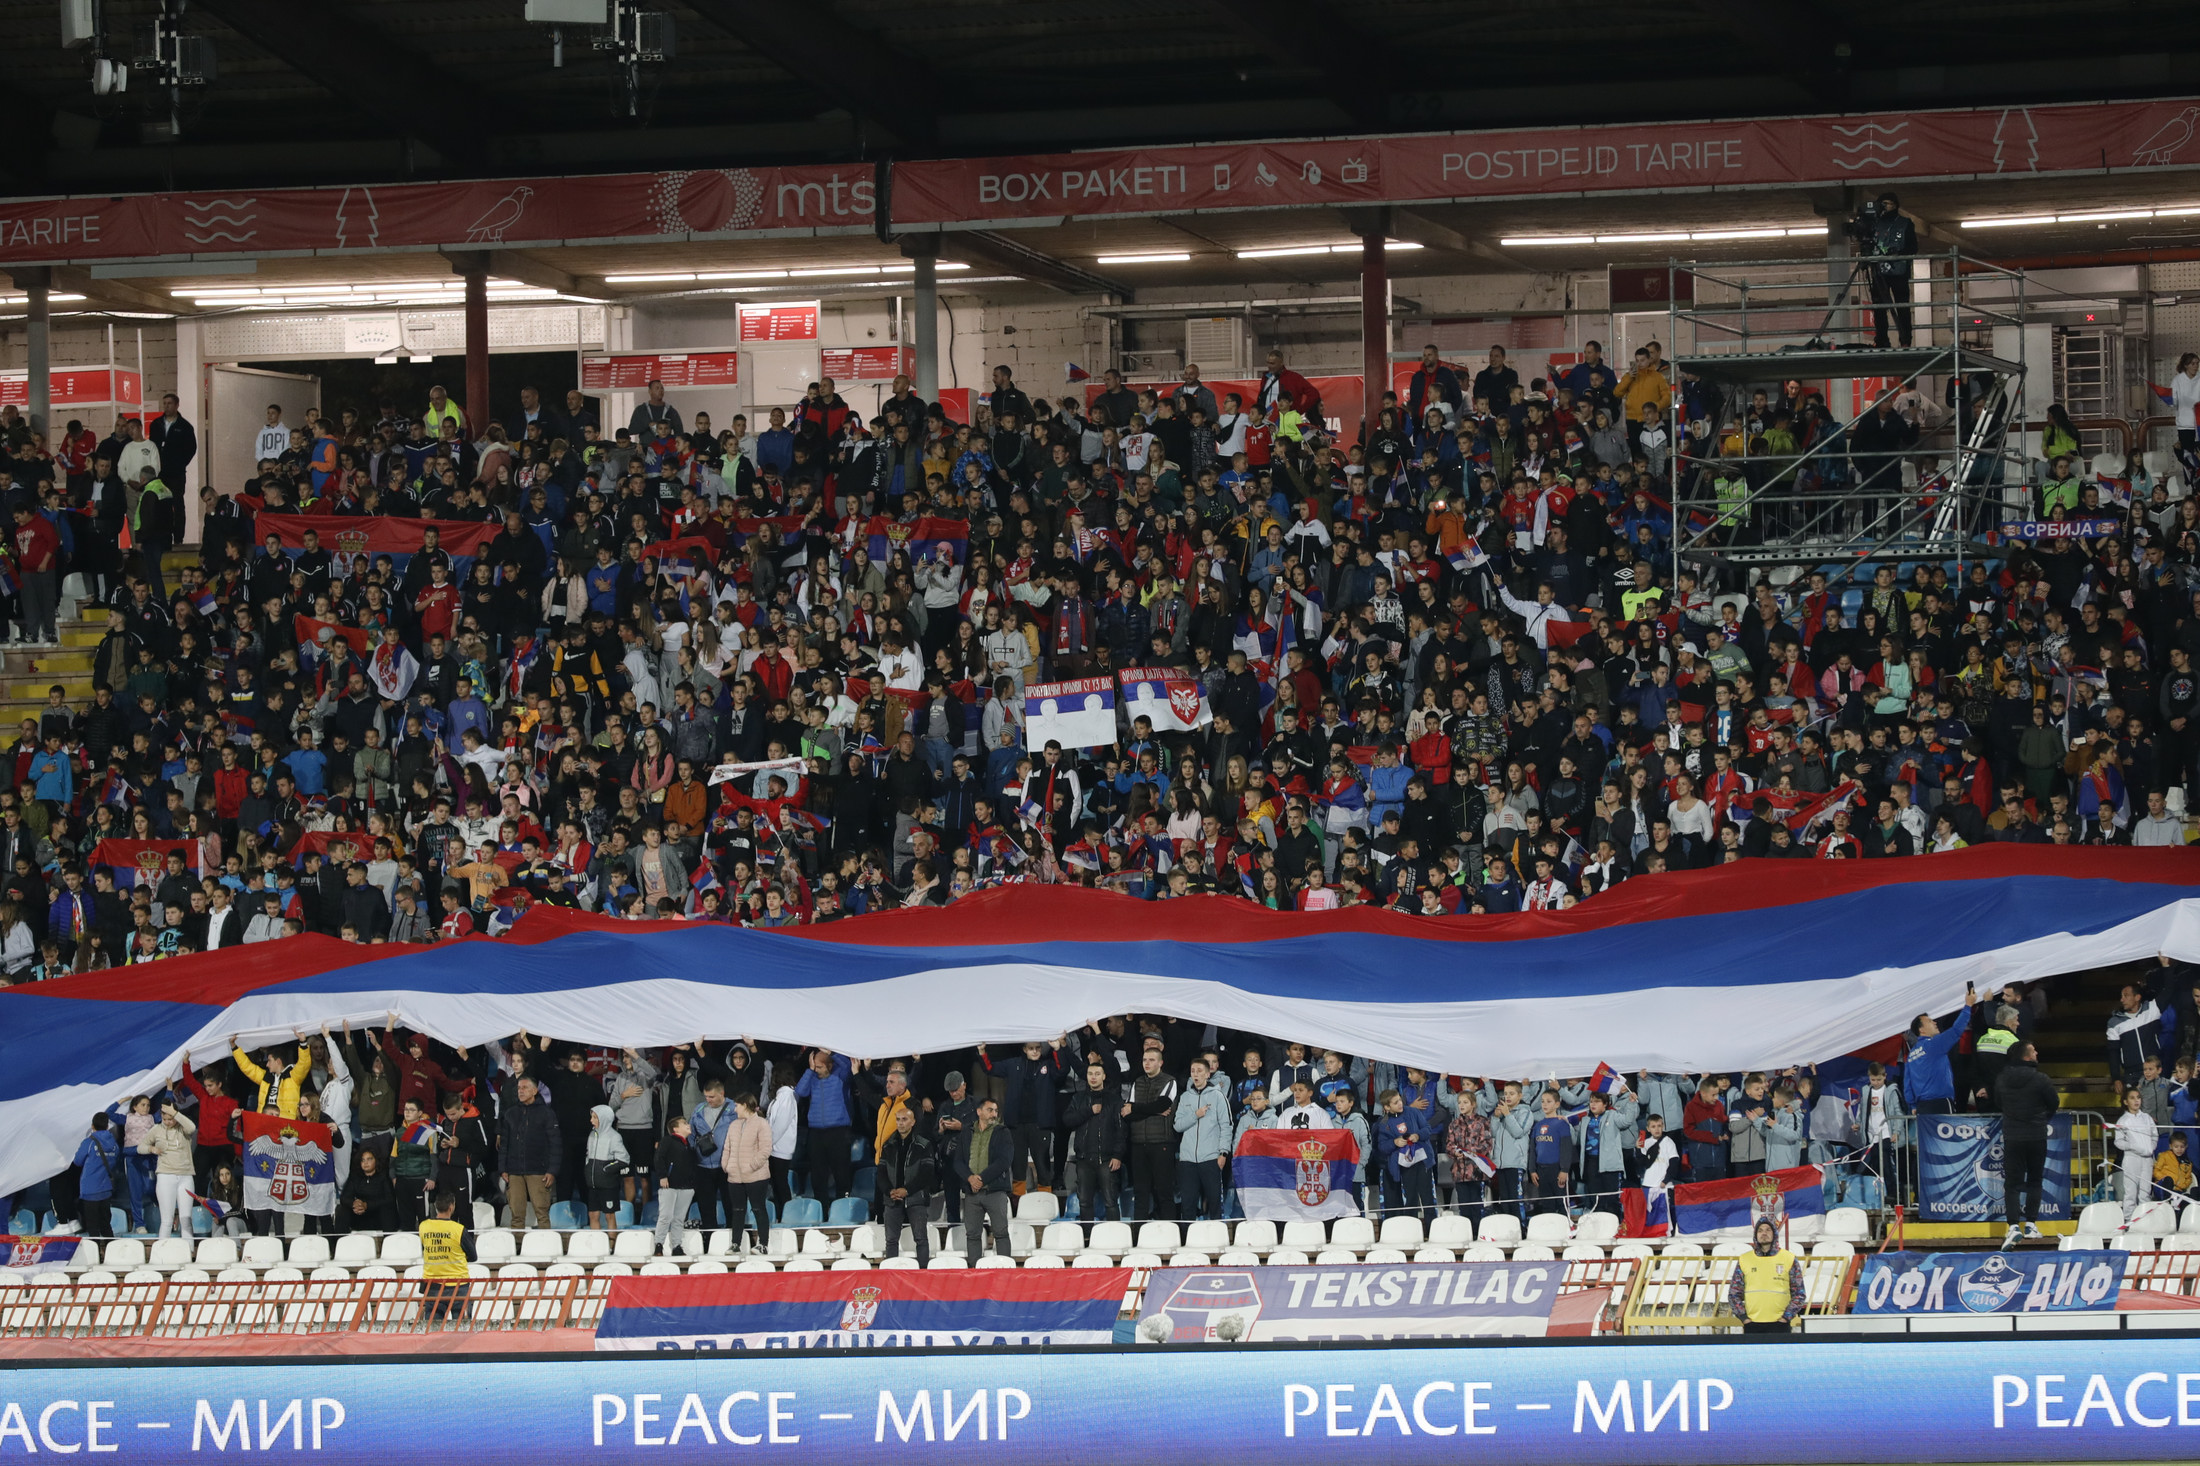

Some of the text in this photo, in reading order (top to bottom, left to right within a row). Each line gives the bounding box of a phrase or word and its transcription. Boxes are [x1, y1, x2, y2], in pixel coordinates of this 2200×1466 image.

[1442, 139, 1743, 181] POSTPEJD TARIFE
[777, 167, 876, 216] mts
[980, 165, 1186, 203] BOX PAKETI
[0, 215, 100, 247] TARIFE
[2023, 522, 2093, 538] СРБИЈА
[1083, 679, 1091, 692] СУ
[1091, 678, 1100, 691] УЗ
[1101, 677, 1112, 690] ВАС
[1755, 738, 1765, 750] 10
[1936, 1122, 1991, 1141] ОФК
[1930, 1201, 1989, 1215] КОСОВСКА
[1287, 1267, 1549, 1309] TEKSTILAC
[1867, 1260, 2114, 1312] ОФК ДИФ
[1979, 1275, 2001, 1283] ОФК
[1192, 1295, 1252, 1307] TEKSTILAC
[1173, 1327, 1217, 1340] DERVE
[592, 1390, 800, 1446] PEACE
[874, 1387, 1032, 1443] МИР
[1283, 1380, 1498, 1437] PEACE
[1572, 1377, 1734, 1434] МИР
[1993, 1371, 2200, 1428] PEACE
[191, 1397, 346, 1452] МИР
